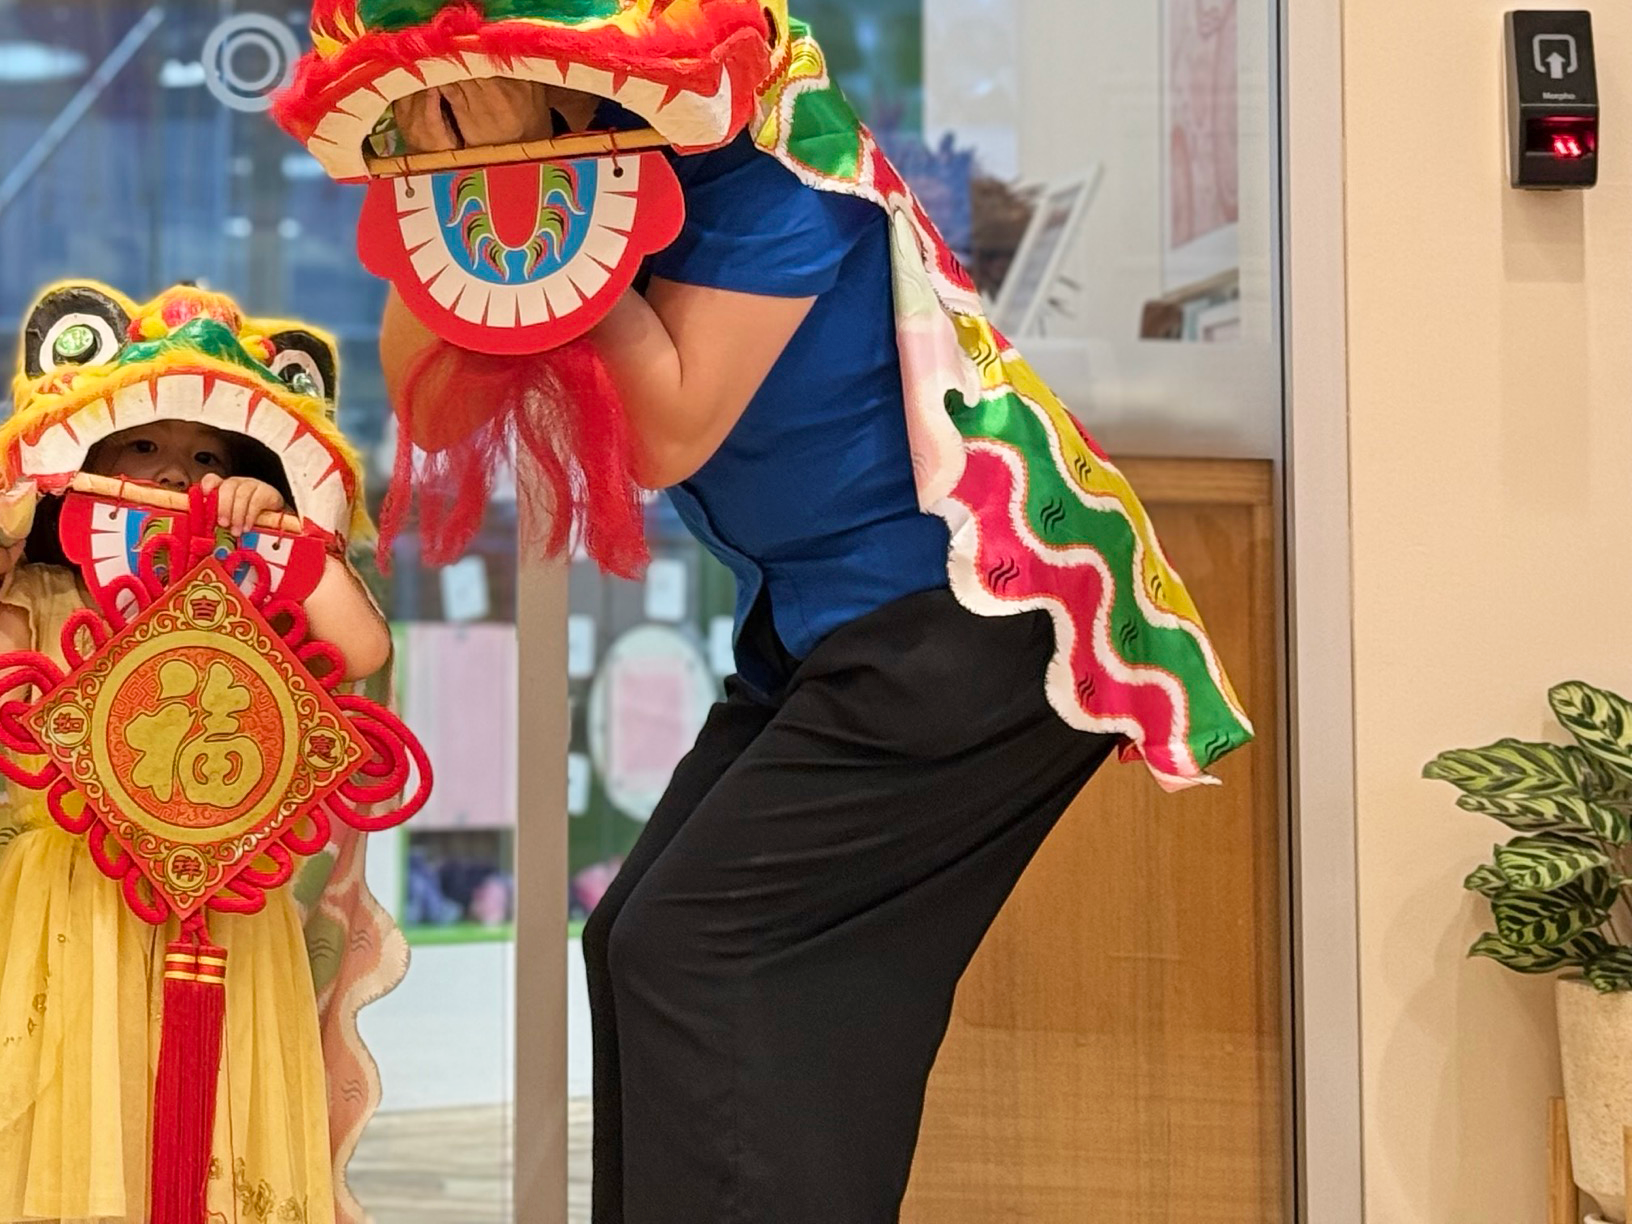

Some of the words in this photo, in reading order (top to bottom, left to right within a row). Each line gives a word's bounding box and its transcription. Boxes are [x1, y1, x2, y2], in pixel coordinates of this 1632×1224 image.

[1542, 92, 1576, 101] Morpho
[191, 595, 221, 622] 吉
[53, 711, 84, 734] 如
[124, 659, 263, 808] 福
[171, 855, 202, 882] 祥
